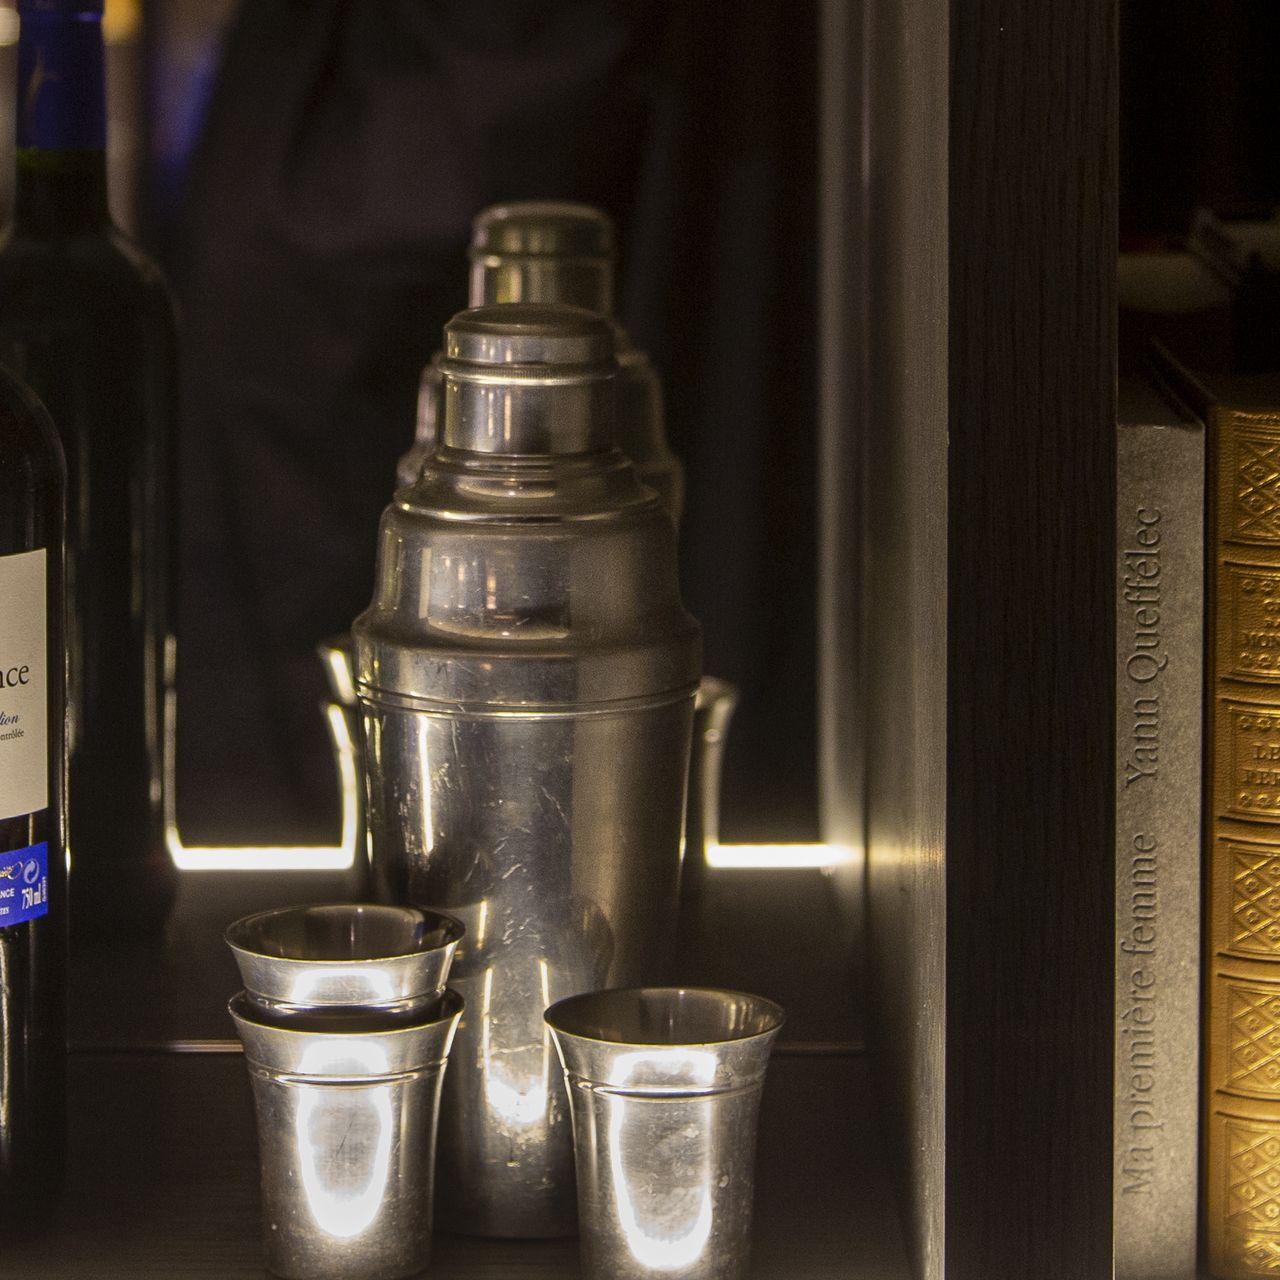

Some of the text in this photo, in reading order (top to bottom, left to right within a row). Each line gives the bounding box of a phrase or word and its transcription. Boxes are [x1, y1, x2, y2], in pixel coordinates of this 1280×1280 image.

[1124, 506, 1169, 790] Yann Queffélec
[1120, 831, 1164, 1197] Ma première femme
